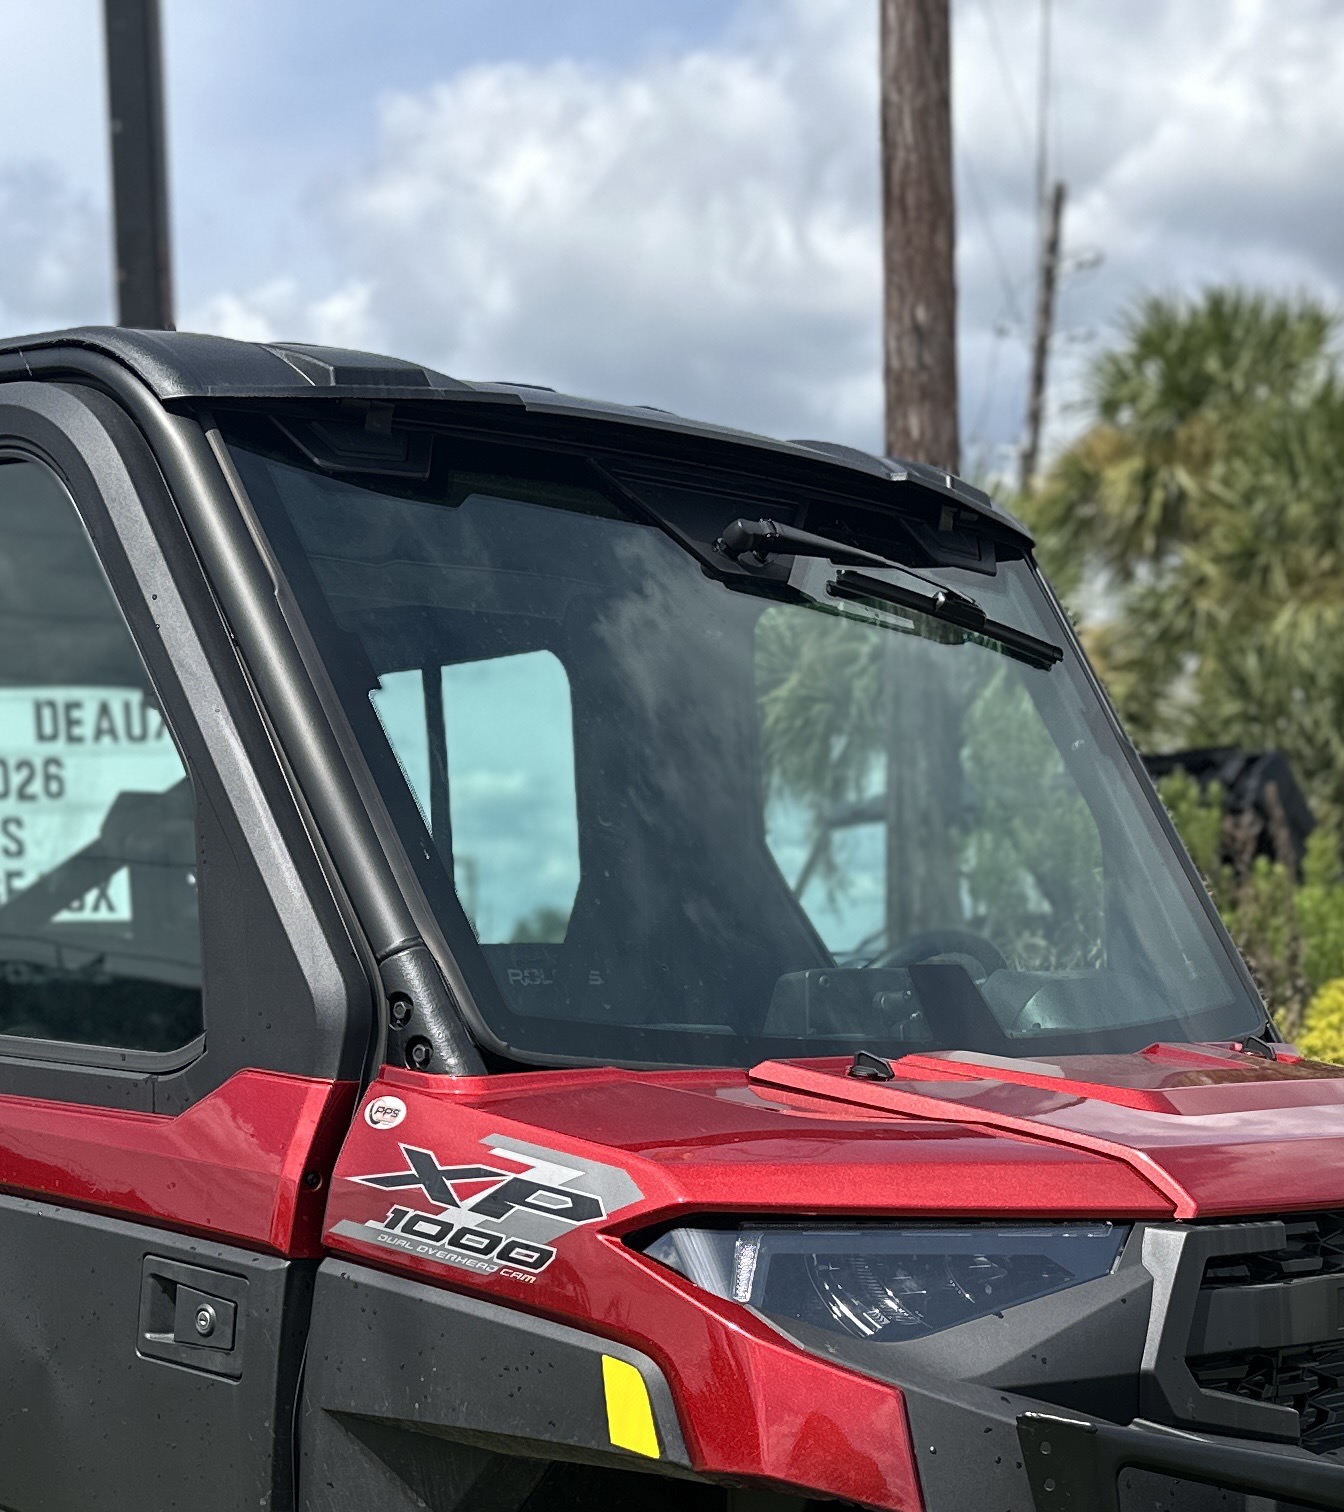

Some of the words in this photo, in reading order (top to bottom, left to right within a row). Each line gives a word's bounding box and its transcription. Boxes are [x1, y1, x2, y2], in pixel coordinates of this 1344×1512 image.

[346, 1143, 606, 1223] XP
[377, 1233, 413, 1249] DUAL
[416, 1245, 498, 1273] OVERHEAD
[499, 1269, 537, 1284] CAM
[382, 1204, 556, 1272] 1000
